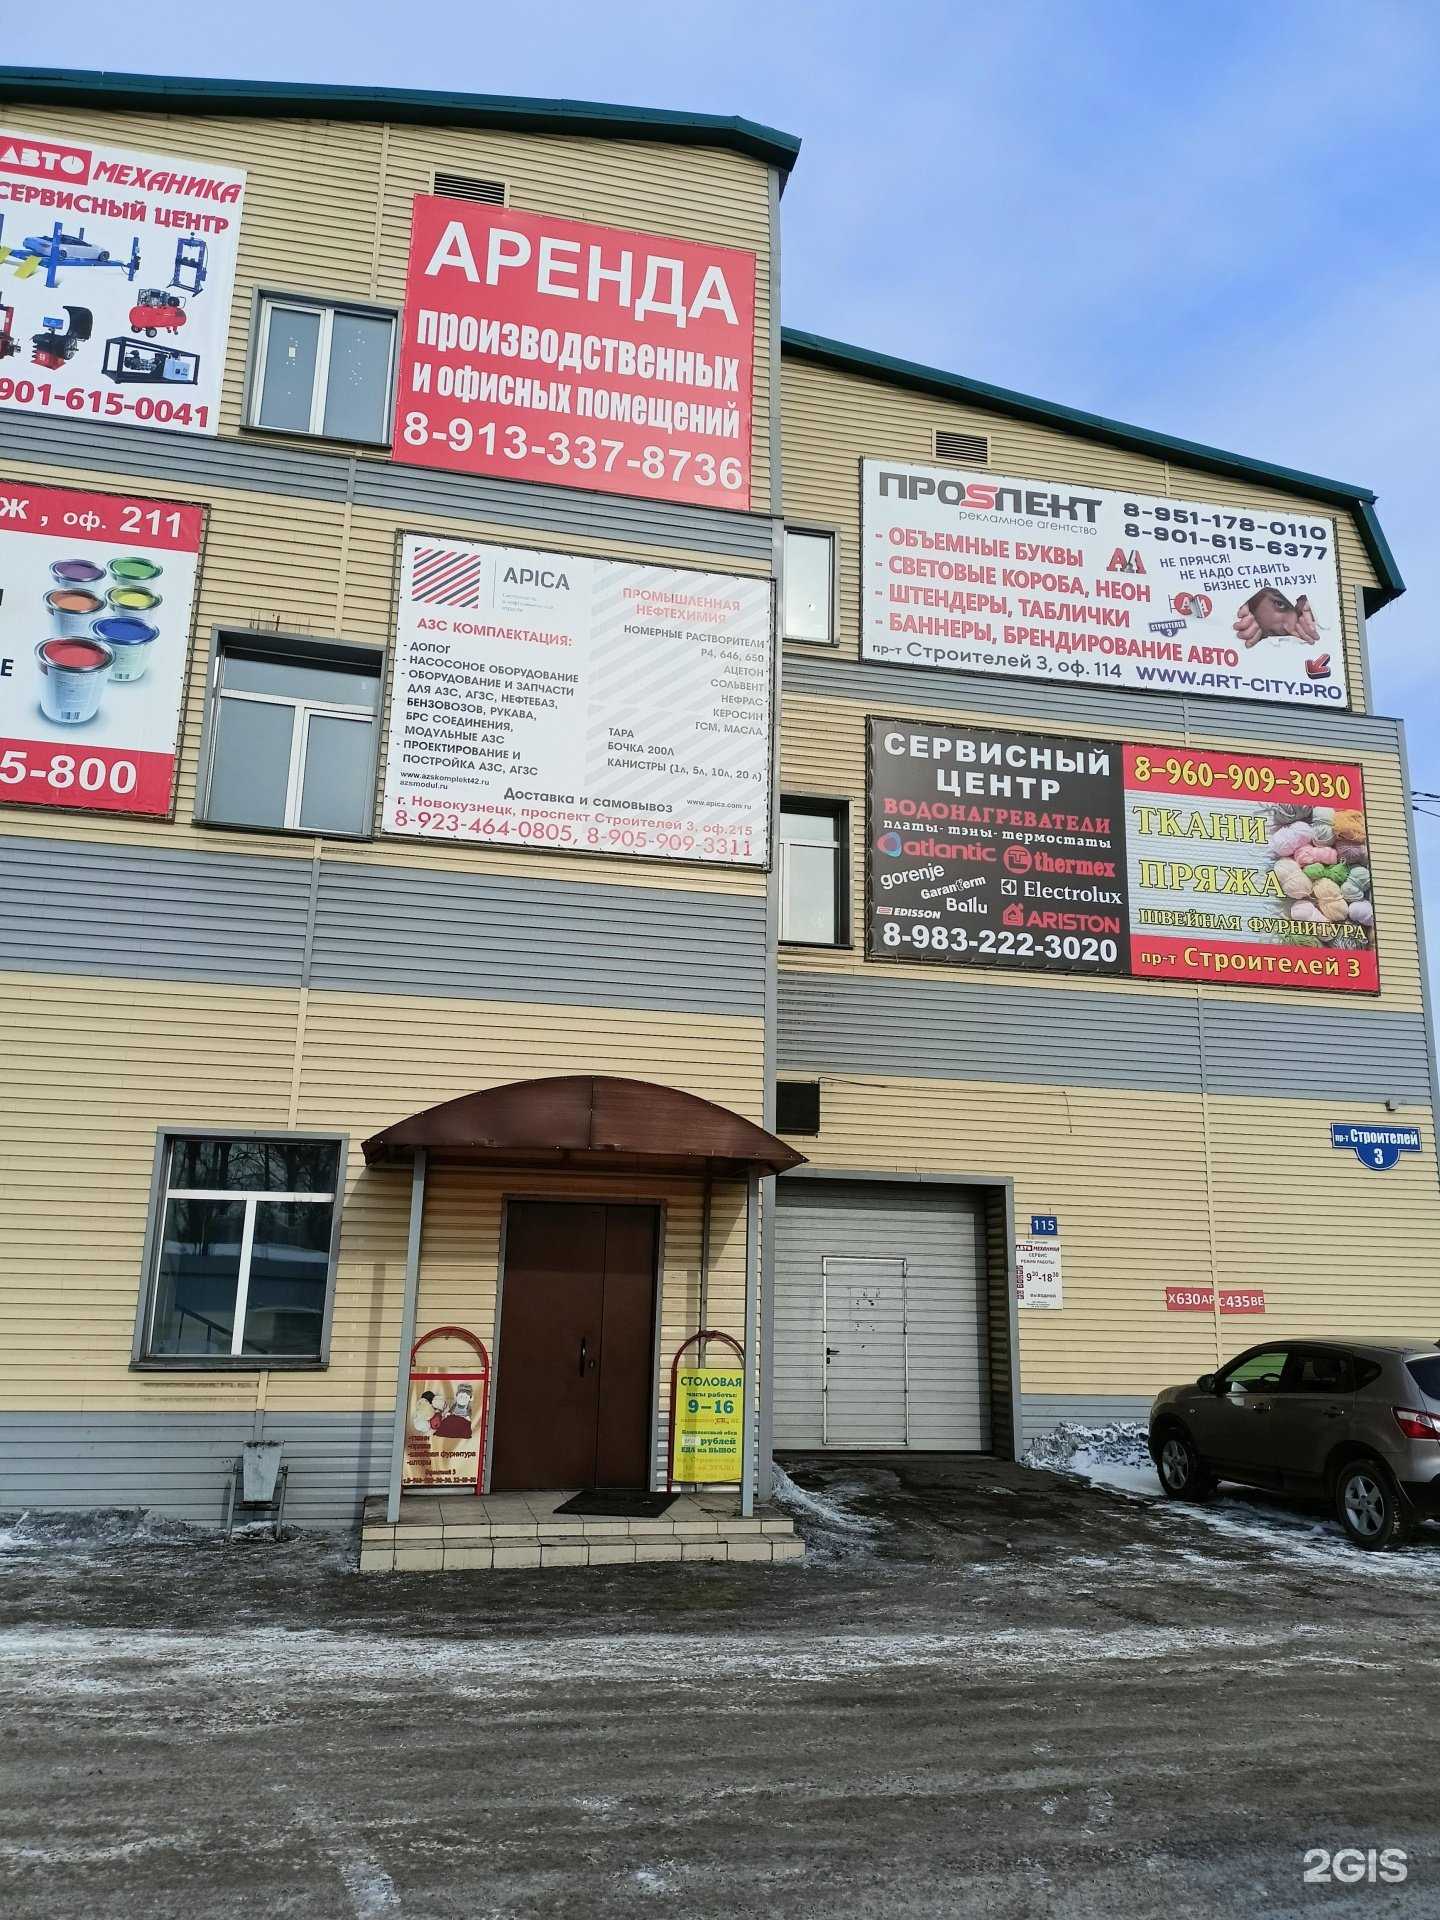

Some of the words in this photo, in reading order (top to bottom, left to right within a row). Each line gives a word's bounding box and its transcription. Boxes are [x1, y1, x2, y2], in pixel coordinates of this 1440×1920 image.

[1, 146, 85, 175] АВТО
[93, 161, 241, 203] МЕХАНИКА
[0, 181, 147, 222] СЕРВИСНЫЙ
[155, 207, 229, 234] ЦЕНТР
[424, 220, 739, 329] АРЕНДА
[416, 309, 740, 392] производственных
[437, 365, 572, 415] офисных
[576, 386, 740, 439] помещений
[403, 411, 743, 490] 8-913-337-8736
[63, 510, 106, 531] оф.
[120, 506, 181, 538] 211
[959, 511, 1033, 528] рекламное
[1037, 521, 1097, 536] агентство
[1123, 502, 1327, 540] 8-951-178-0110
[889, 527, 1010, 559] ОБЪЕМНЫЕ
[1015, 542, 1084, 567] БУКВЫ
[1124, 523, 1328, 561] 8-901-615-6377
[1160, 557, 1176, 568] НЕ
[1179, 553, 1231, 567] ПРЯЧСЯ!
[1180, 570, 1196, 580] НЕ
[1199, 567, 1234, 580] НАДО
[1237, 563, 1290, 576] СТАВИТЬ
[889, 556, 997, 585] СВЕТОВЫЕ
[1002, 569, 1090, 599] КОРОБА,
[1095, 579, 1151, 602] НЕОН
[1203, 578, 1250, 592] БИЗНЕС
[1254, 577, 1272, 588] НА
[1275, 574, 1317, 587] ПАУЗУ!
[623, 588, 741, 611] ПРОМЫШЛЕННАЯ
[889, 583, 1013, 617] ШТЕНДЕРЫ,
[1018, 599, 1130, 628] ТАБЛИЧКИ
[636, 604, 727, 624] НЕФТЕХИМИЯ
[417, 618, 447, 631] АЗС
[453, 622, 572, 647] КОМПЛЕКТАЦИЯ:
[624, 625, 683, 639] НОМЕРНЫЕ
[687, 632, 765, 648] РАСТВОРИТЕЛИ
[889, 613, 998, 644] БАННЕРЫ,
[1003, 626, 1183, 662] БРЕНДИРОВАНИЕ
[1187, 645, 1239, 667] АВТО
[409, 655, 485, 672] НАСОСОНОЕ
[489, 665, 579, 683] ОБОРУДОВАНИЕ
[745, 653, 764, 662] 650
[872, 643, 902, 655] пр-т
[906, 641, 1031, 670] Строителей
[1058, 661, 1090, 677] оф.
[1094, 662, 1122, 679] 114
[408, 669, 501, 688] ОБОРУДОВАНИЕ
[505, 680, 513, 689] И
[516, 681, 574, 696] ЗАПЧАСТИ
[723, 665, 764, 677] АЦЕТОН
[1136, 665, 1342, 700] WWW.ART-CITY.PRO
[407, 684, 431, 694] ДЛЯ
[435, 686, 461, 698] АЗС,
[465, 690, 497, 702] АГЗС,
[501, 694, 558, 709] НЕФТЕБАЗ,
[710, 679, 764, 692] СОЛЬВЕНТ
[407, 697, 486, 716] БЕНЗОВОЗОВ,
[490, 707, 537, 721] РУКАВА,
[721, 694, 763, 706] НЕФРАС
[406, 711, 429, 722] БРС
[432, 714, 514, 732] СОЕДИНЕНИЯ,
[713, 708, 763, 720] КЕРОСИН
[405, 725, 478, 742] МОДУЛЬНЫЕ
[481, 734, 505, 744] АЗС
[609, 728, 635, 738] ТАРА
[724, 724, 763, 736] МАСЛА
[403, 740, 509, 759] ПРОЕКТИРОВАНИЕ
[512, 751, 521, 760] И
[608, 742, 644, 753] БОЧКА
[884, 732, 1110, 776] СЕРВИСНЫЙ
[402, 754, 475, 770] ПОСТРОЙКА
[479, 761, 506, 774] АЗС,
[509, 766, 538, 776] АГЗС
[607, 758, 666, 772] КАНИСТРЫ
[736, 770, 749, 779] 20
[936, 768, 1060, 800] ЦЕНТР
[1133, 756, 1350, 800] 8-960-909-3030
[504, 787, 575, 804] Доставка
[579, 796, 588, 805] и
[592, 798, 673, 813] самовывоз
[412, 796, 516, 817] Новокузнецк,
[521, 807, 590, 824] проспект
[595, 813, 682, 831] Строителей
[883, 798, 1111, 834] ВОДОНАГРЕВАТЕЛИ
[1133, 805, 1268, 844] ТКАНИ
[394, 810, 578, 845] 8-923-464-0805,
[588, 827, 752, 856] 8-905-909-3311
[1001, 831, 1111, 849] термостаты
[903, 839, 998, 862] atlantic
[880, 863, 945, 890] gorenje
[1034, 852, 1116, 878] thermex
[1139, 860, 1286, 897] ПРЯЖА
[1024, 880, 1123, 905] Electrolux
[893, 907, 941, 919] EDISSON
[946, 897, 988, 914] Ballu
[1026, 911, 1120, 934] ARISTON
[1139, 908, 1242, 931] ШВЕЙНАЯ
[1247, 917, 1367, 941] ФУРНИТУРА
[883, 922, 1117, 962] 8-983-222-3020
[1141, 951, 1176, 965] пр-т
[1184, 947, 1339, 976] Строителей
[1347, 958, 1360, 977] 3
[1350, 1128, 1418, 1145] Строителей
[1373, 1148, 1383, 1164] 3
[1034, 1220, 1055, 1231] 115
[680, 1376, 742, 1387] СТОЛОВАЯ
[700, 1437, 736, 1446] рублей
